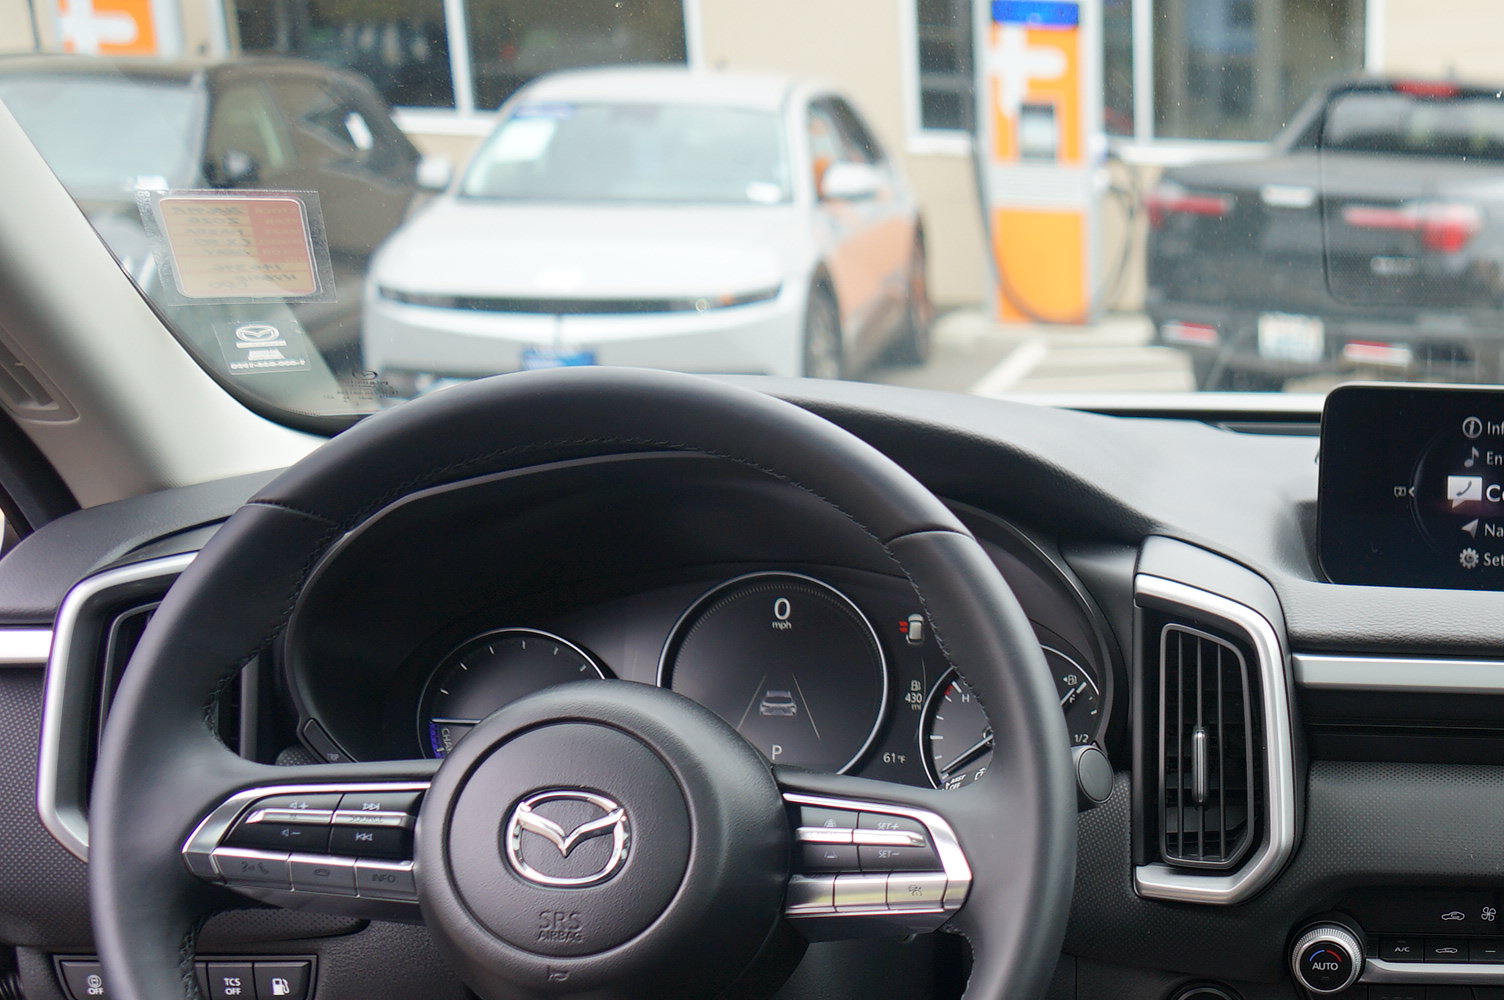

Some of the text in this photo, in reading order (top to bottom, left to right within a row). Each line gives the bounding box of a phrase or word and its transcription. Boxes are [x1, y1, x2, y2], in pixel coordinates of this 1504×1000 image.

[774, 597, 791, 620] 0
[771, 620, 792, 632] mph
[905, 692, 922, 703] 430
[1074, 734, 1089, 743] 1/2
[771, 745, 782, 760] P
[373, 874, 396, 883] INFO
[539, 911, 582, 930] SRS
[538, 930, 583, 942] AIRBAG
[1394, 946, 1410, 954] A/C
[1312, 962, 1339, 971] AUTO
[224, 978, 240, 987] TCS
